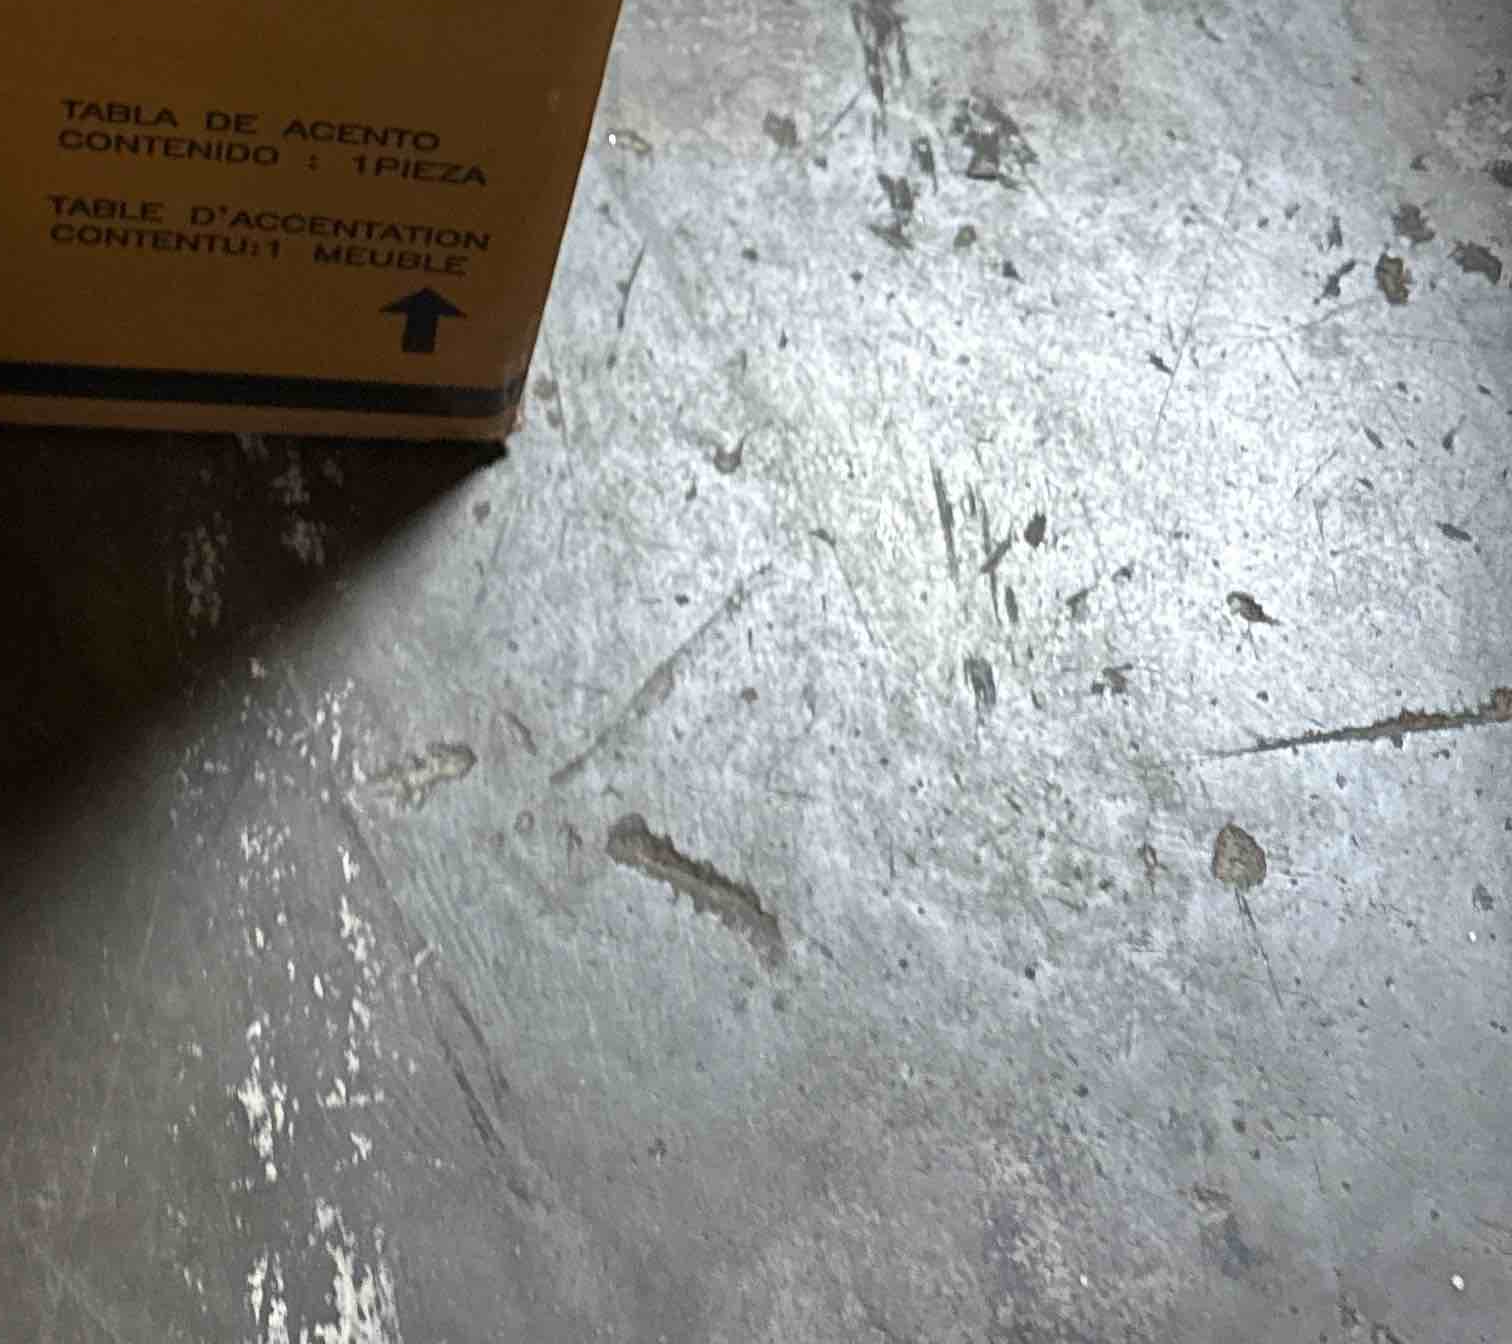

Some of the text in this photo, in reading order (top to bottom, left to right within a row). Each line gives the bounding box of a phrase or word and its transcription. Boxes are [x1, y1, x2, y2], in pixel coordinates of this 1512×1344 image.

[60, 97, 441, 152] TABLA DE ACENTO
[57, 128, 280, 167] CONTENIDO
[352, 152, 488, 187] 1PIEZA
[47, 193, 492, 252] TABLE D'ACCENTATION
[312, 244, 469, 277] MEUBLE
